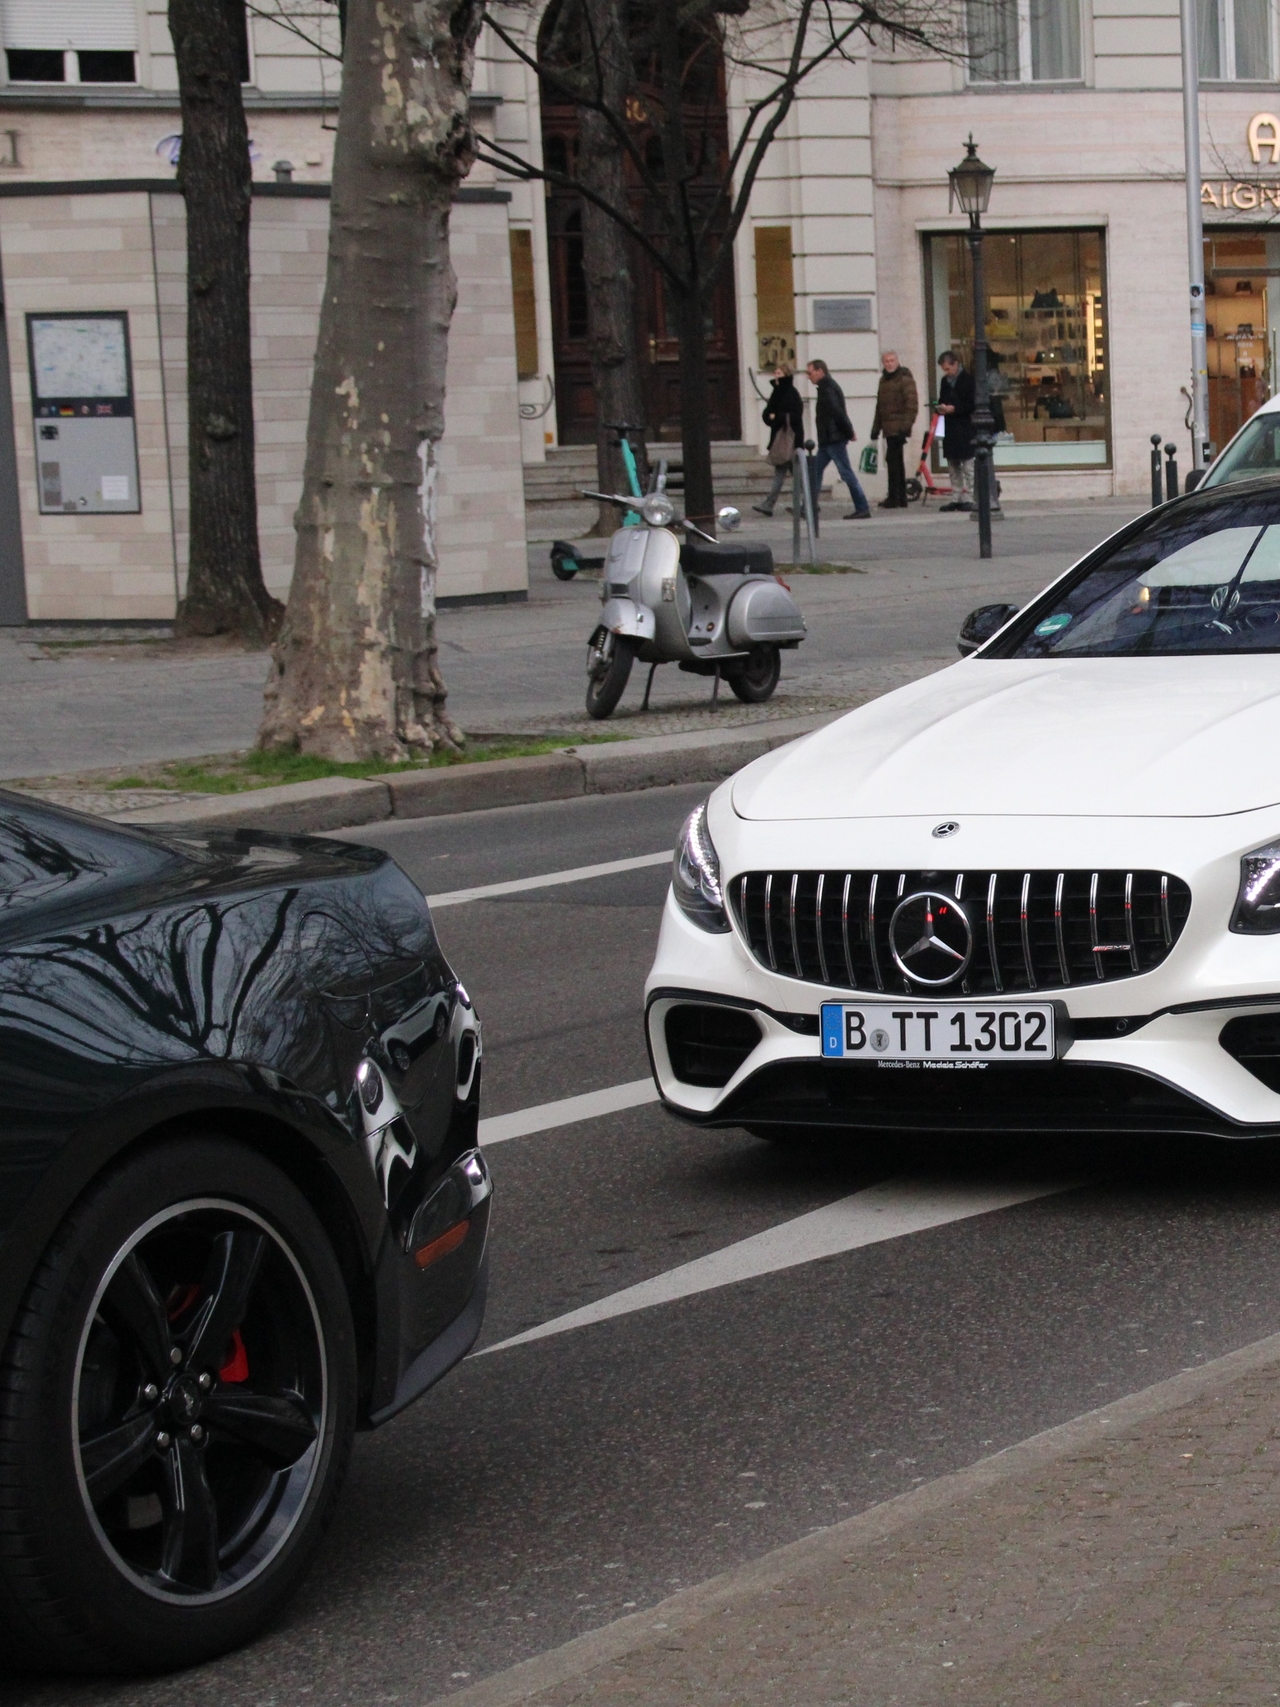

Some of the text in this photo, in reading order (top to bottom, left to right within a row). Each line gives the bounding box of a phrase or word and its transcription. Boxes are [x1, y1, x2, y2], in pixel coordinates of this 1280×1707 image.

[845, 1011, 1048, 1052] B TT 1302
[829, 1036, 838, 1049] D
[878, 1060, 921, 1069] Mercedes-Benz
